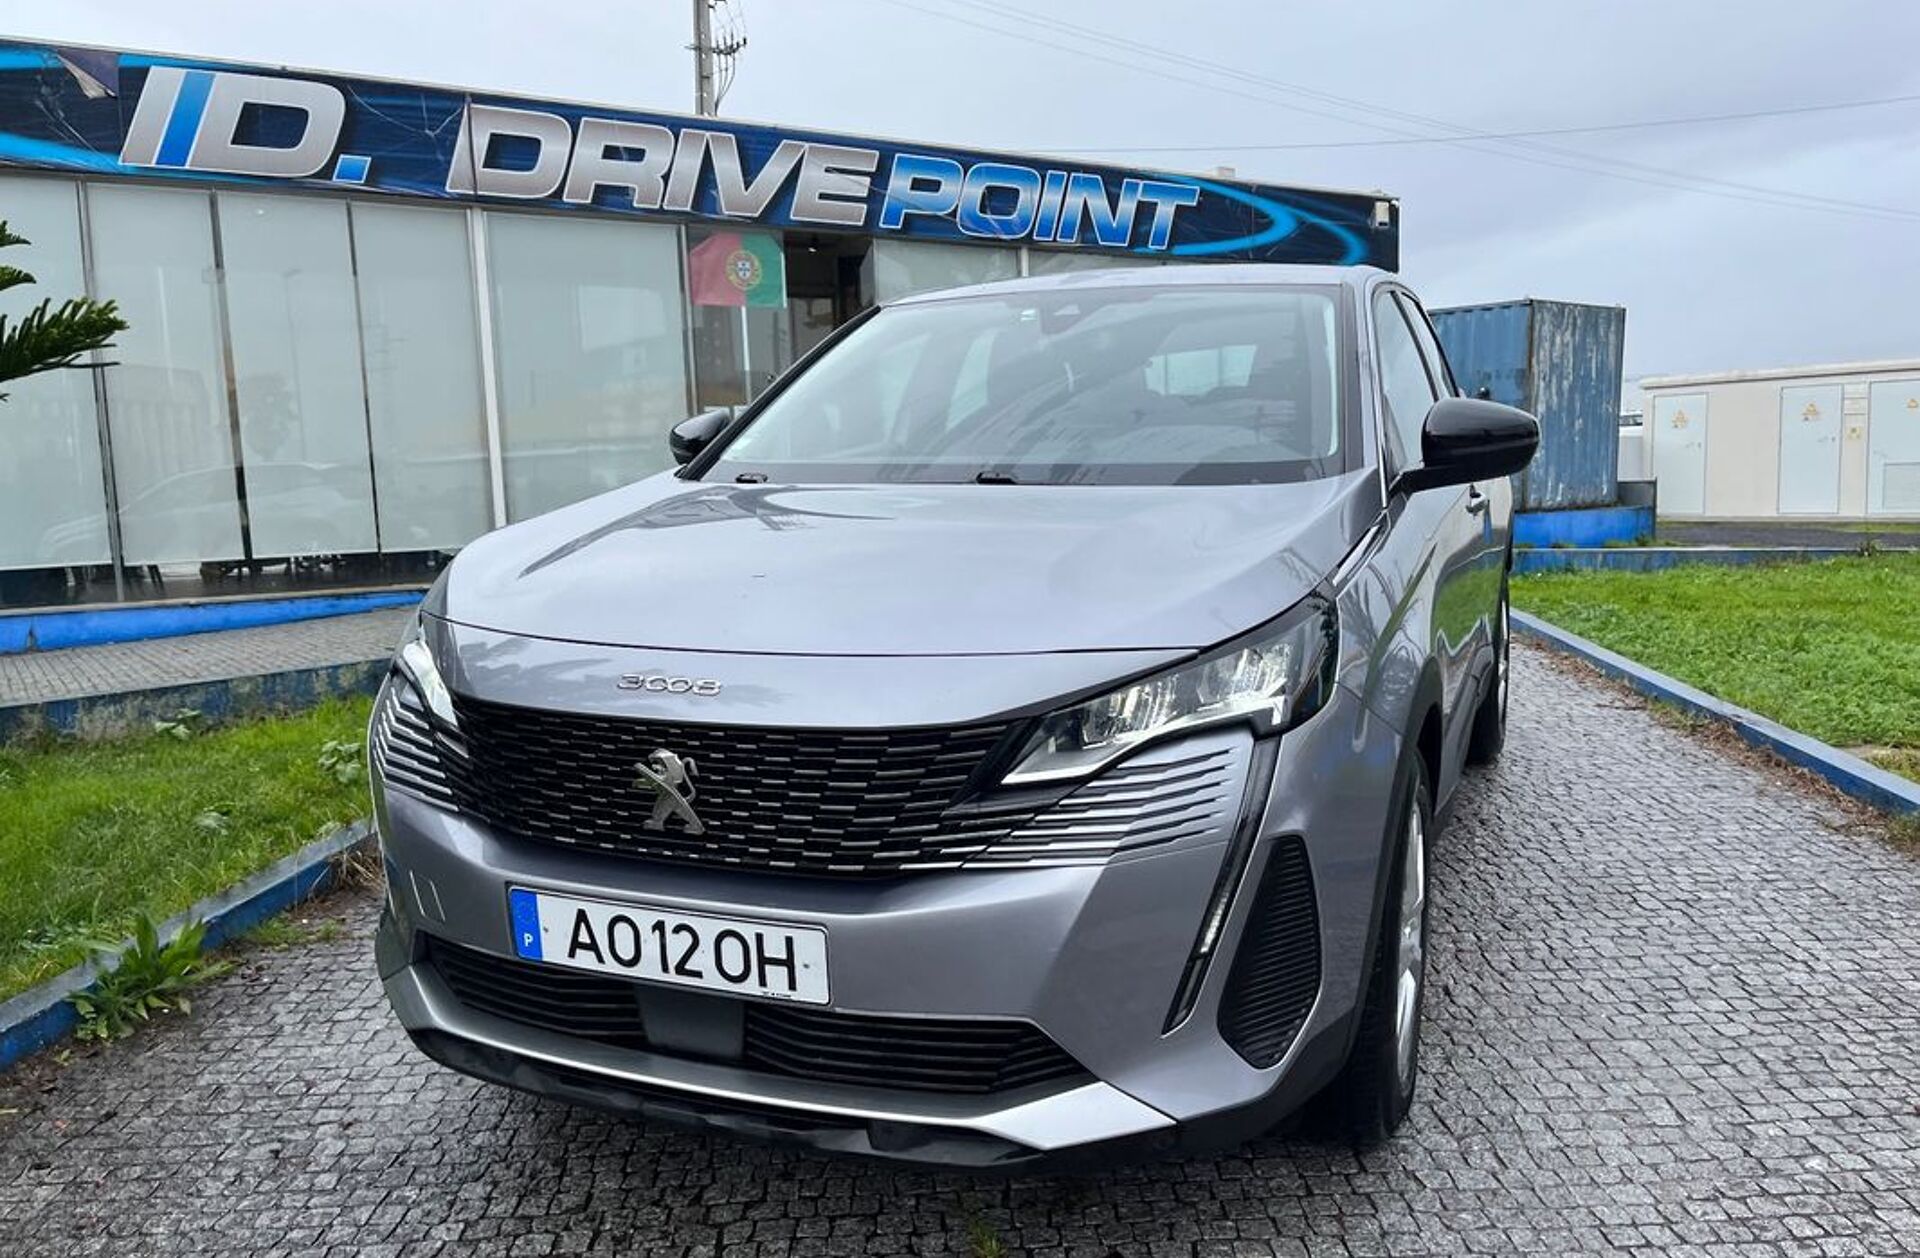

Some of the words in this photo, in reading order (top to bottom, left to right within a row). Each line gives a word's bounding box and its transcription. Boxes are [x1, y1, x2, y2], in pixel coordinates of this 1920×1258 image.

[118, 65, 372, 184] ID.
[617, 673, 722, 696] 3008
[523, 932, 534, 948] P
